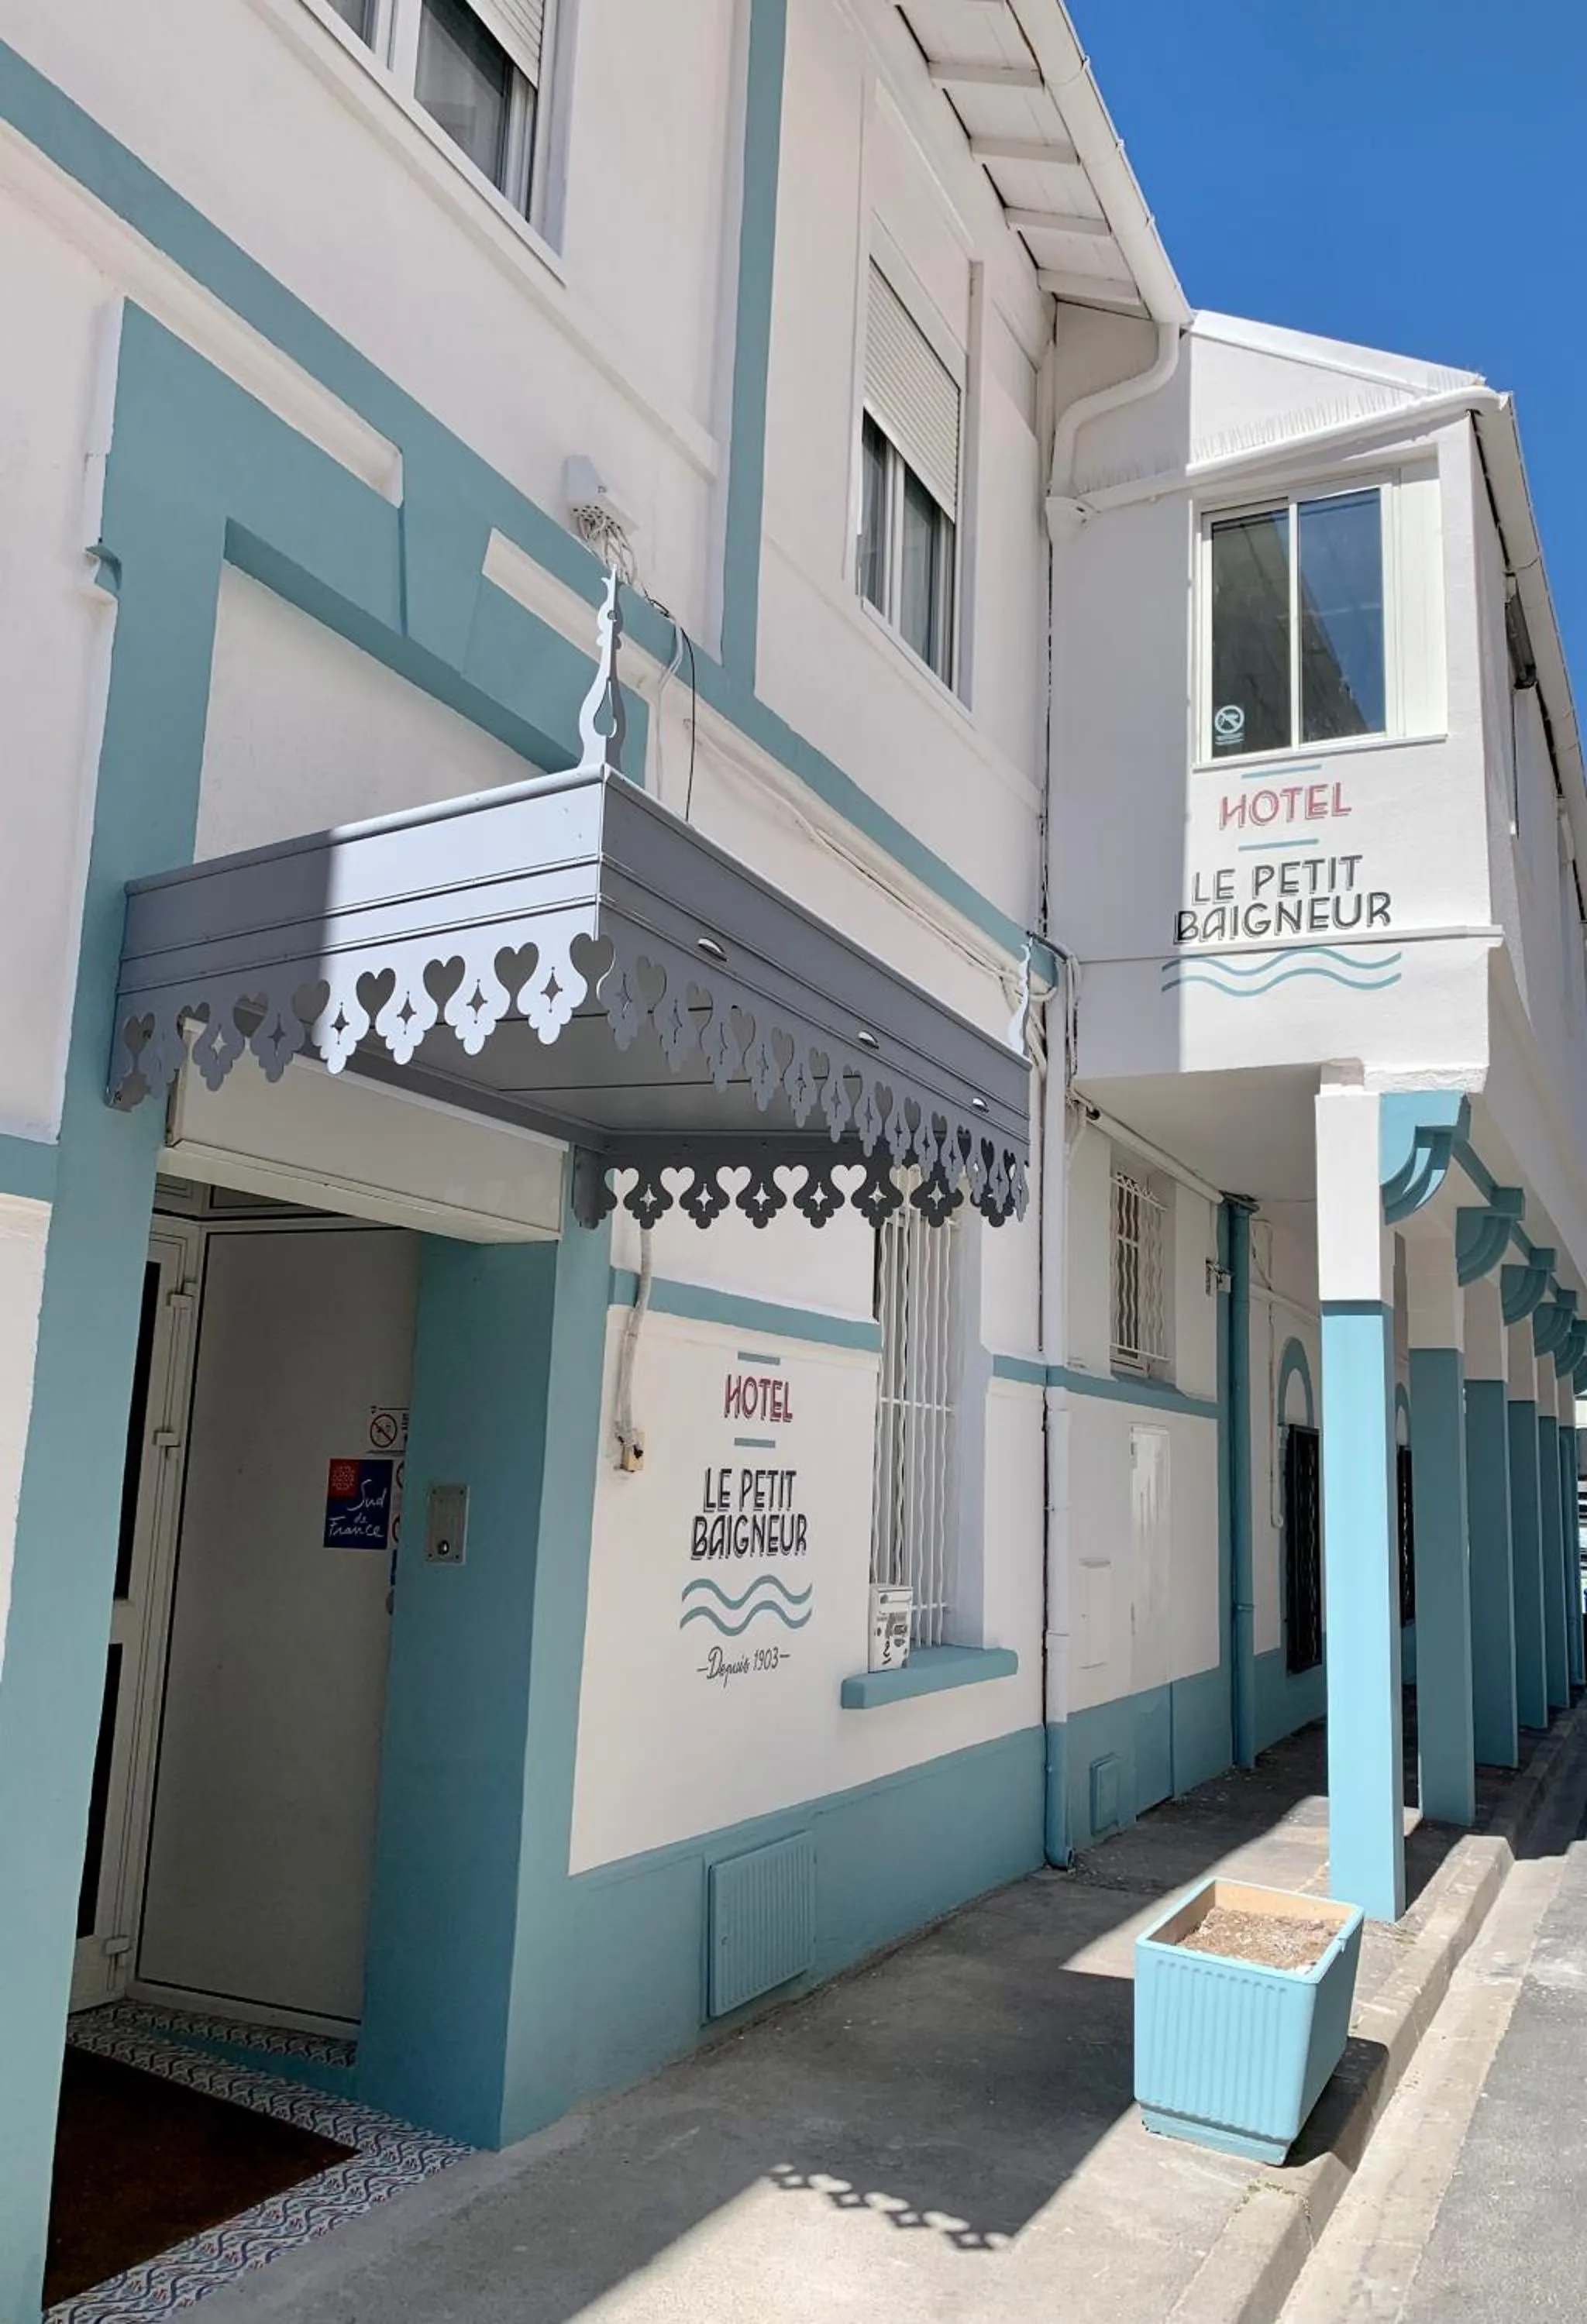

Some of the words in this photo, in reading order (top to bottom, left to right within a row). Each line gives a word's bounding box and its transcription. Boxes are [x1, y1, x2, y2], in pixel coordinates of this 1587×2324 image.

[1219, 782, 1352, 831] HOTEL
[1192, 868, 1235, 906] LE
[1252, 854, 1362, 899] PETIT
[1173, 892, 1392, 945] BAIGNEUR
[724, 1374, 793, 1422] HOTEL
[347, 1479, 387, 1511] Sud
[704, 1467, 732, 1513] LE
[739, 1470, 797, 1511] PETIT
[329, 1515, 384, 1537] France
[690, 1513, 807, 1560] BAIGNEUR
